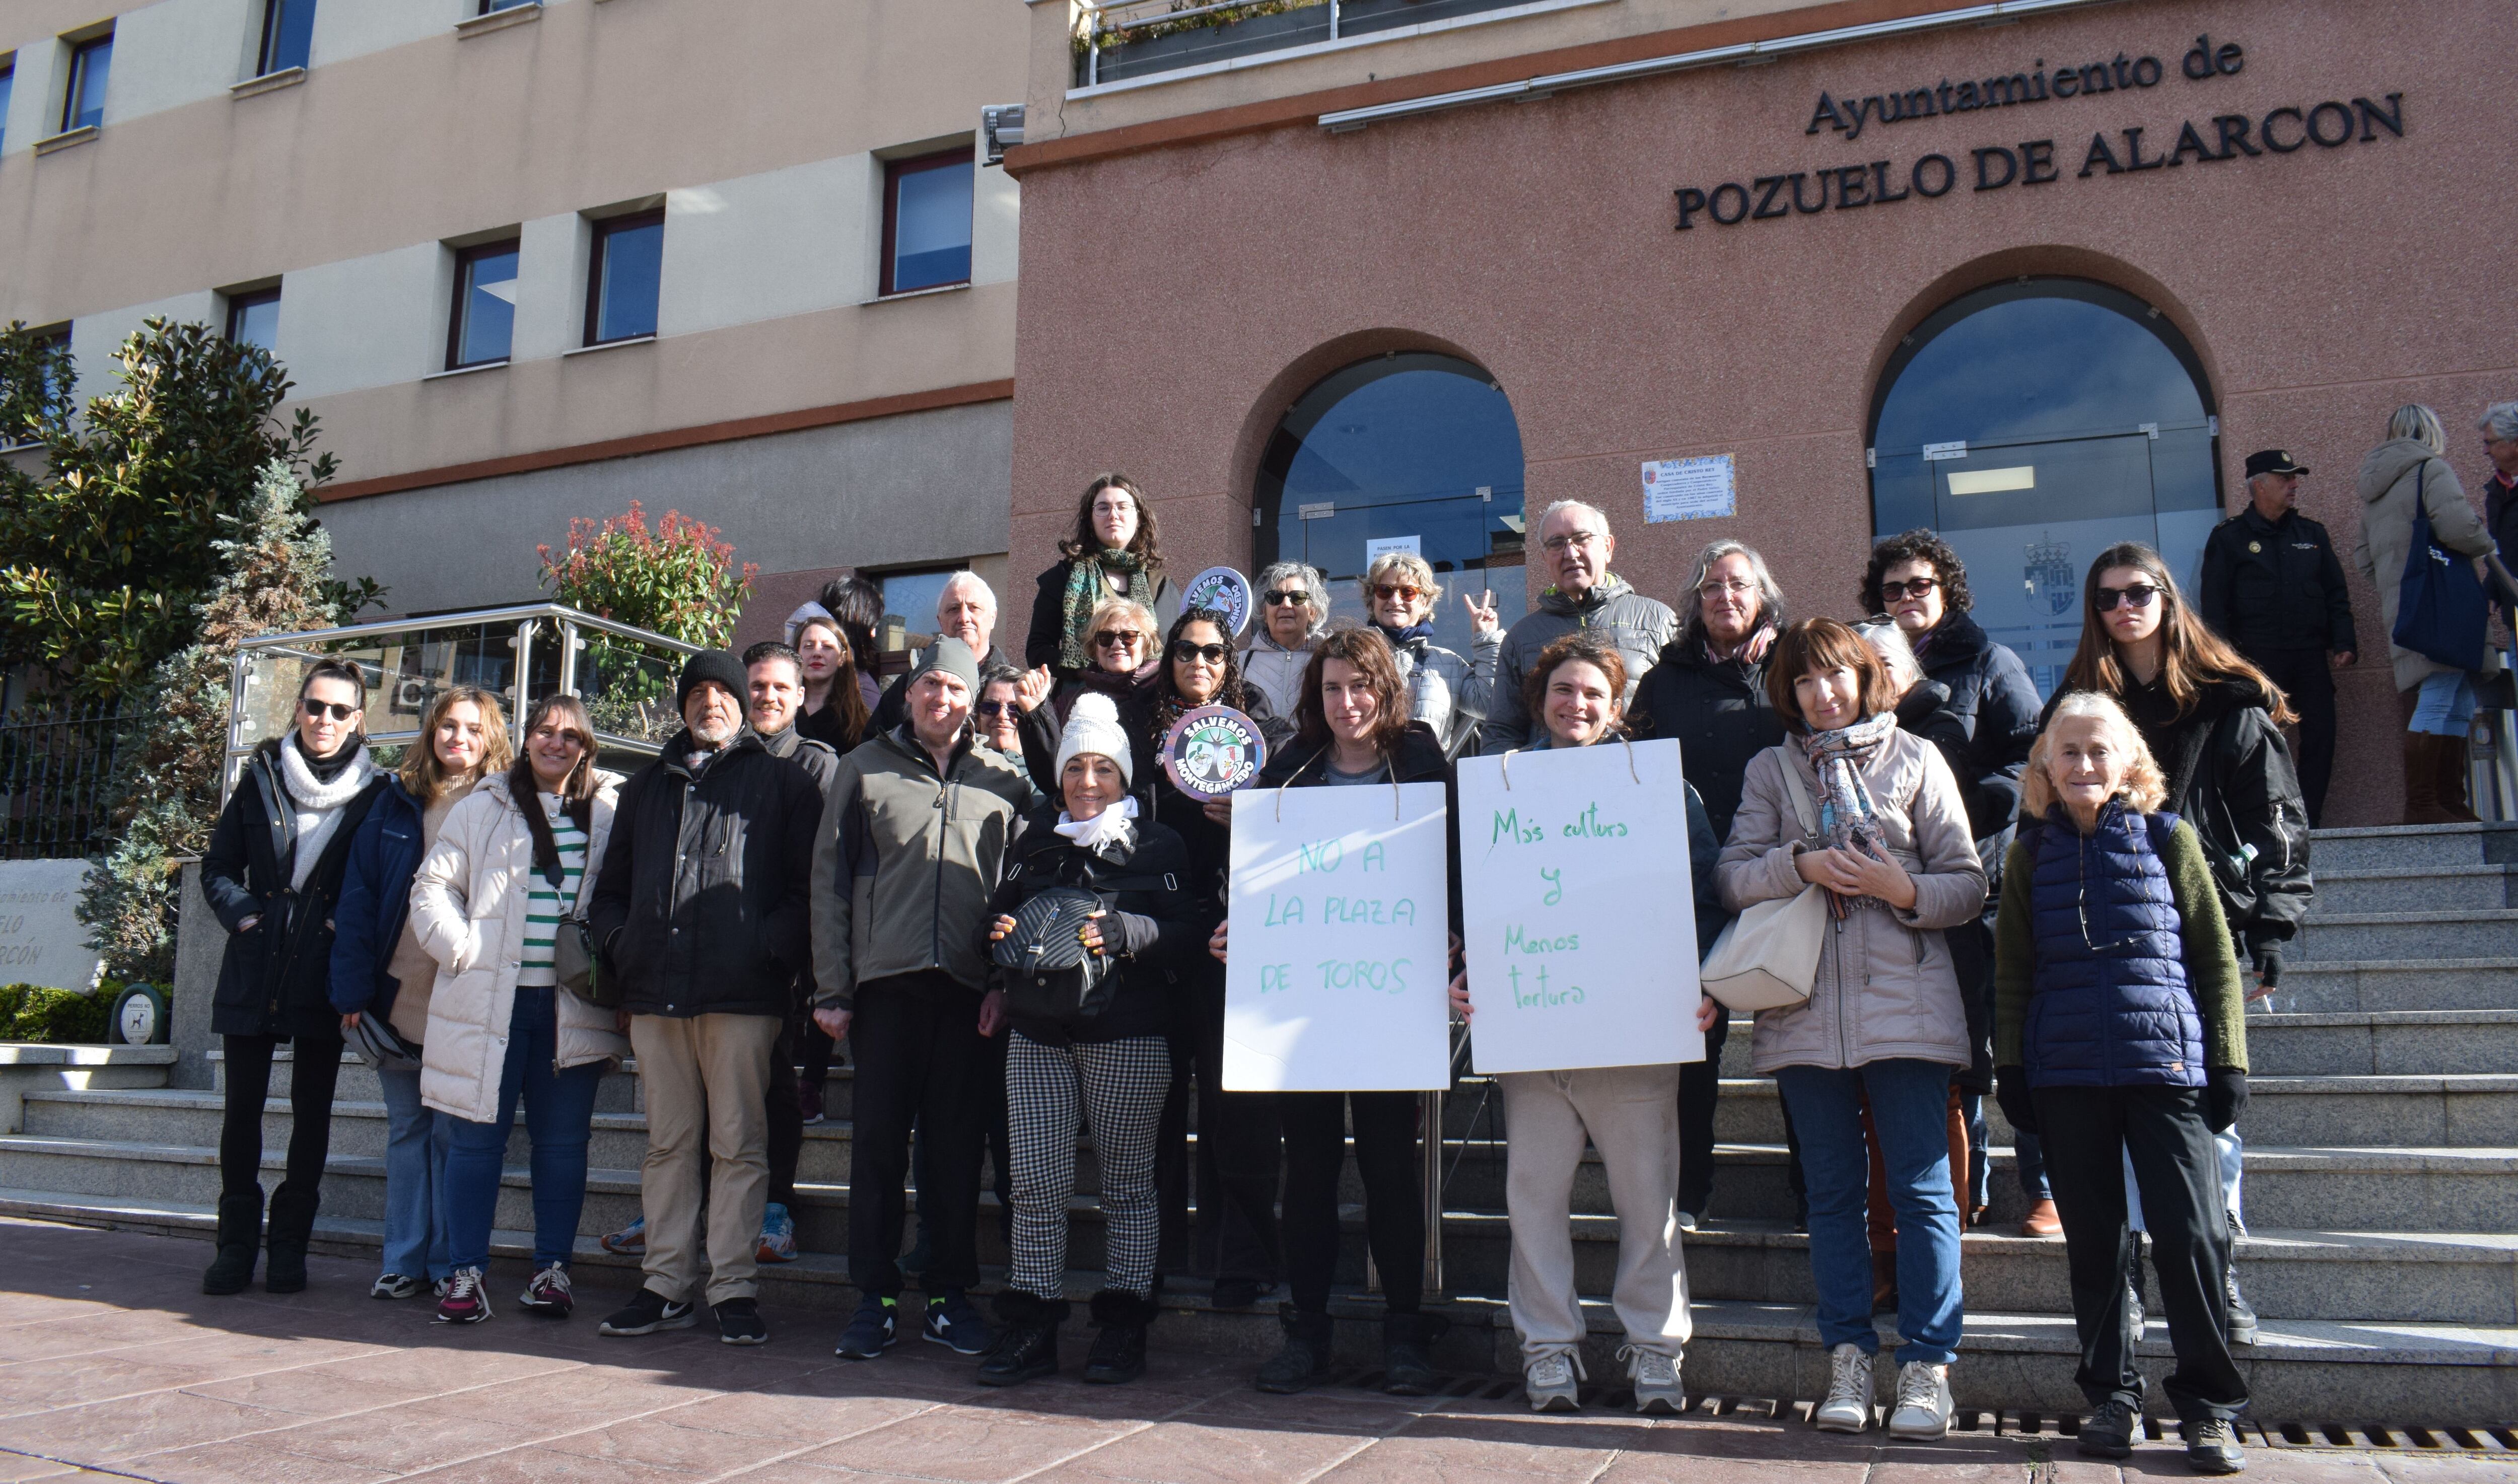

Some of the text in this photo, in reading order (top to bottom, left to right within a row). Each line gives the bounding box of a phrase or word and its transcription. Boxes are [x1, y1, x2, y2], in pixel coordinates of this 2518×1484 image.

[1805, 33, 2244, 139] Ayuntamiento de
[1673, 92, 2404, 230] POZUELO DE ALARCON
[1189, 576, 1224, 607] LVEMOS
[1184, 717, 1252, 746] SALVEMOS
[1175, 758, 1254, 794] MONTEGANCEDO
[1493, 801, 1628, 844] Más cultura
[1299, 839, 1385, 874] NO A
[52, 888, 68, 903] de
[1265, 893, 1416, 927] LA PLAZA
[1504, 924, 1579, 955] Menos
[1261, 957, 1413, 995] DE TOROS
[1508, 964, 1585, 1009] tortura
